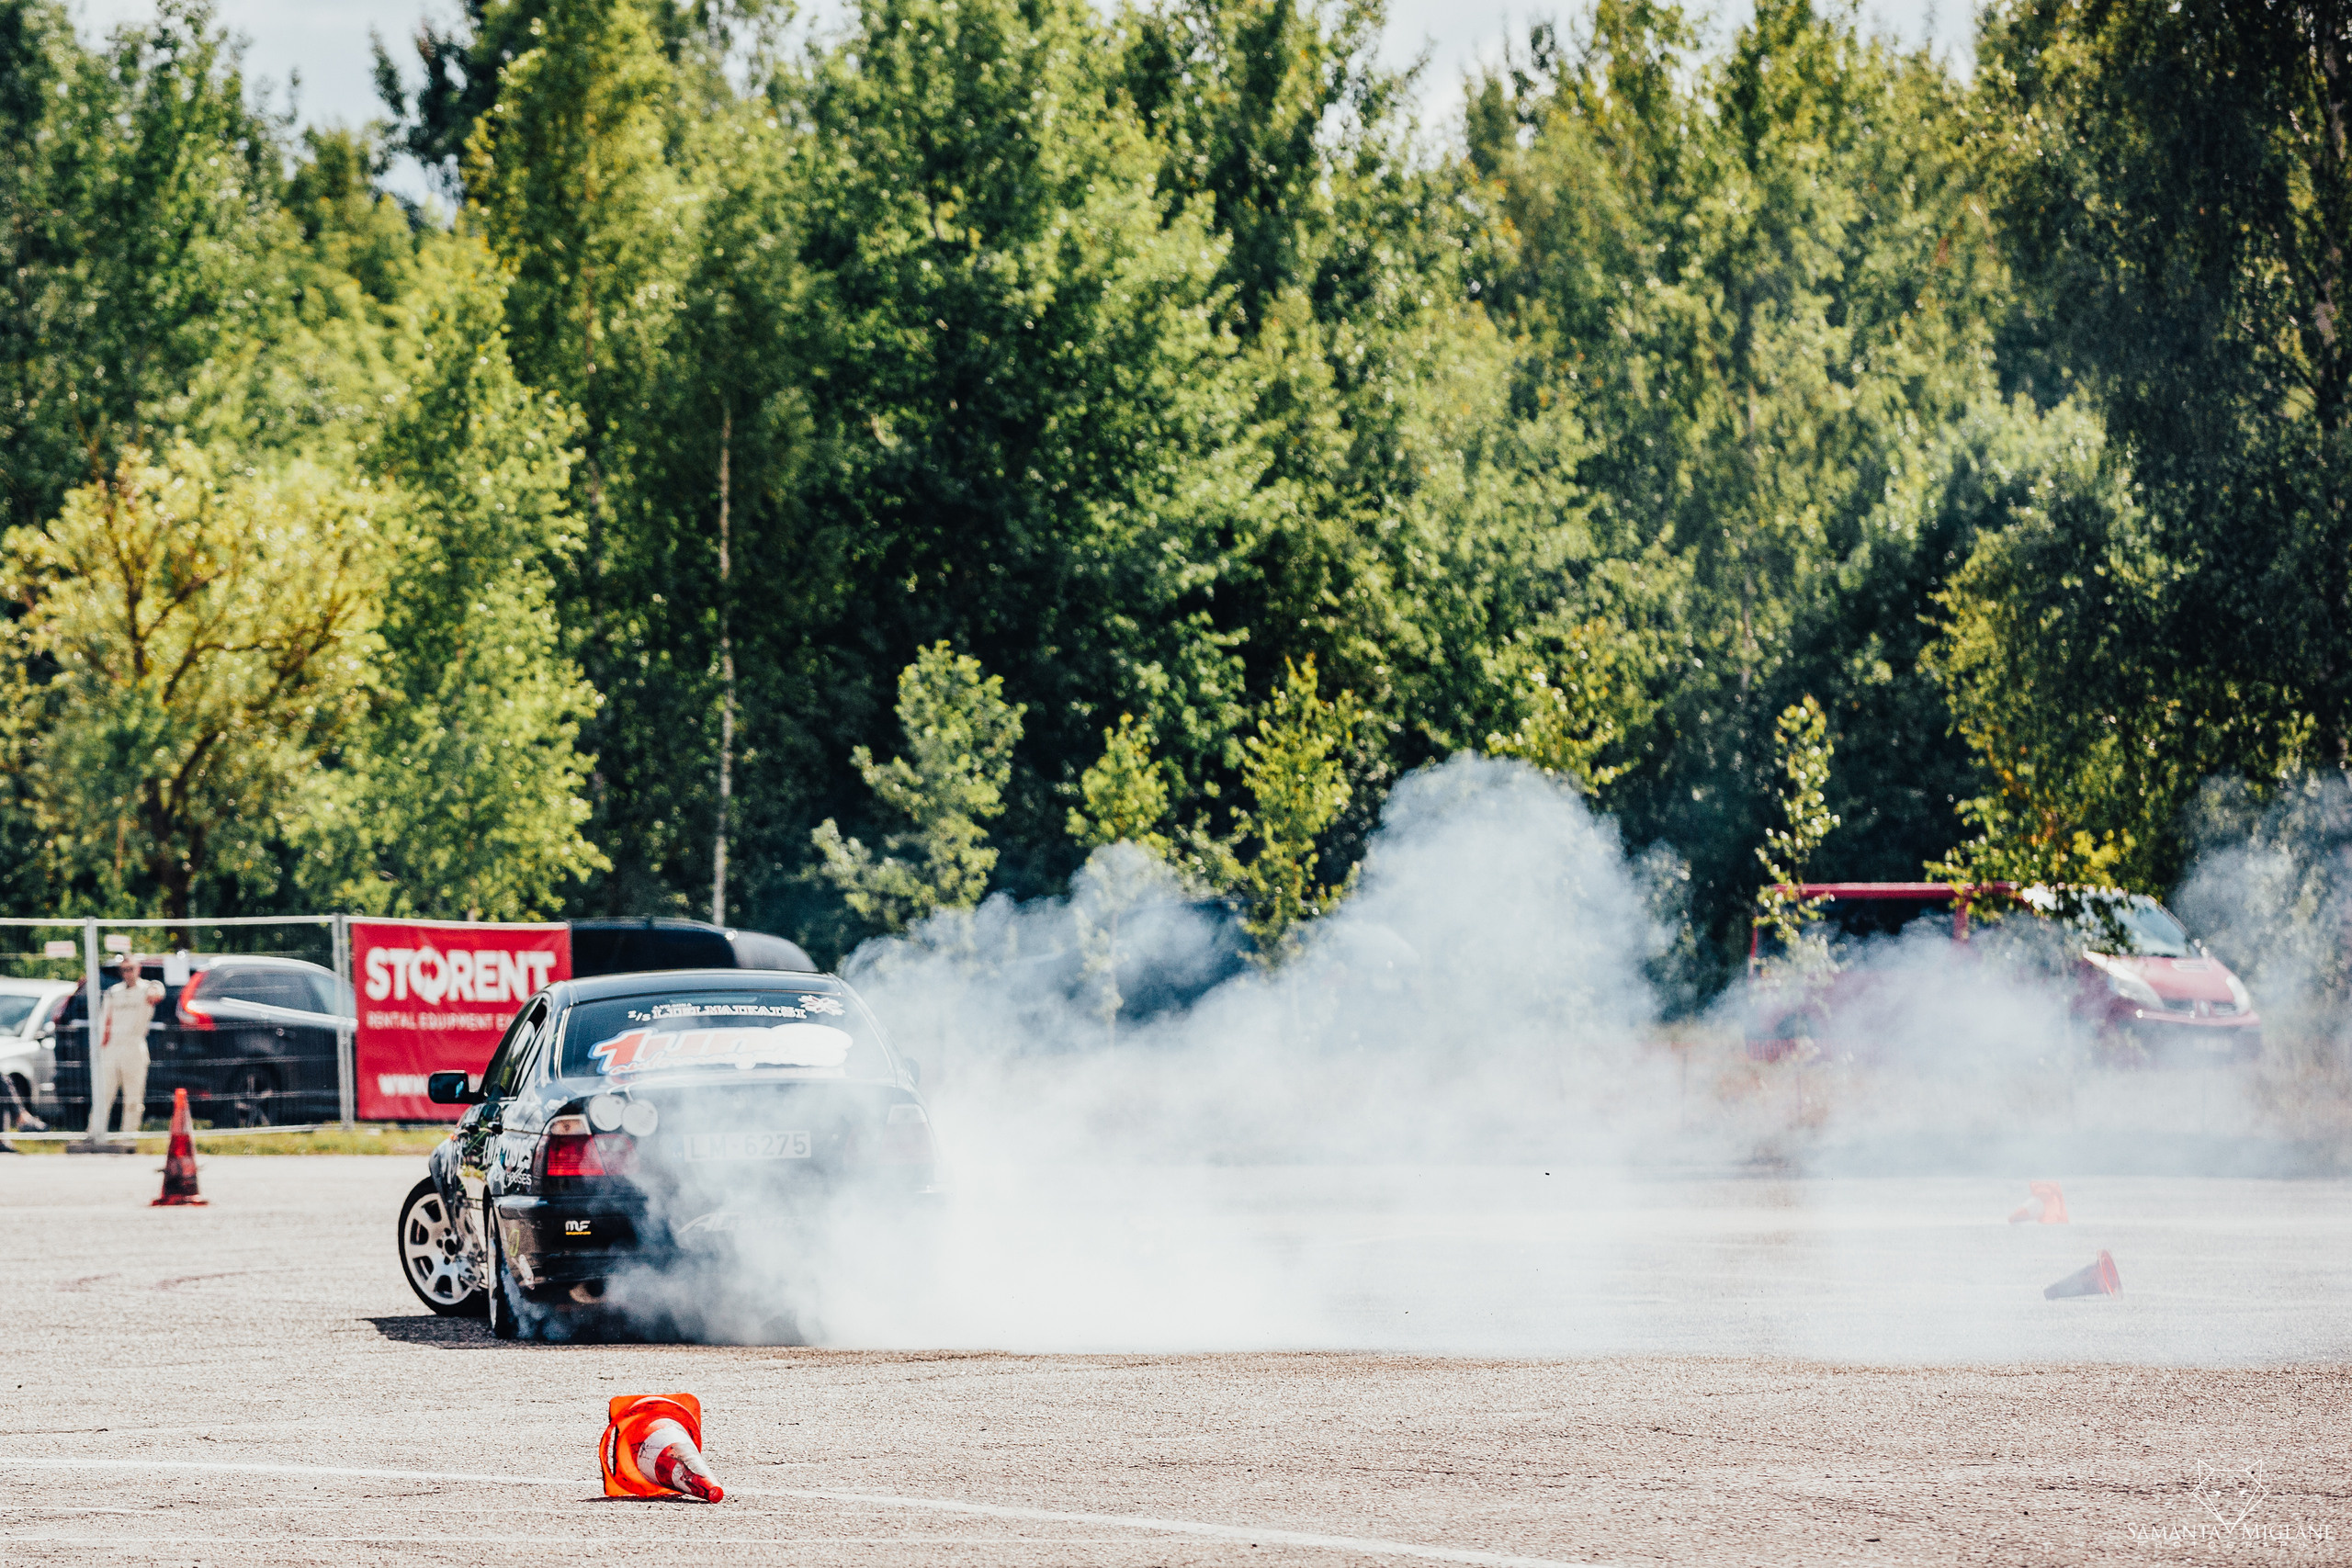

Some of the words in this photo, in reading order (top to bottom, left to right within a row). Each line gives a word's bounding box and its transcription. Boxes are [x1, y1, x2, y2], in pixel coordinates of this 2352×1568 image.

[365, 945, 556, 1006] STORENT
[367, 1010, 417, 1030] RENTAL
[418, 1012, 494, 1032] EQUIPMENT
